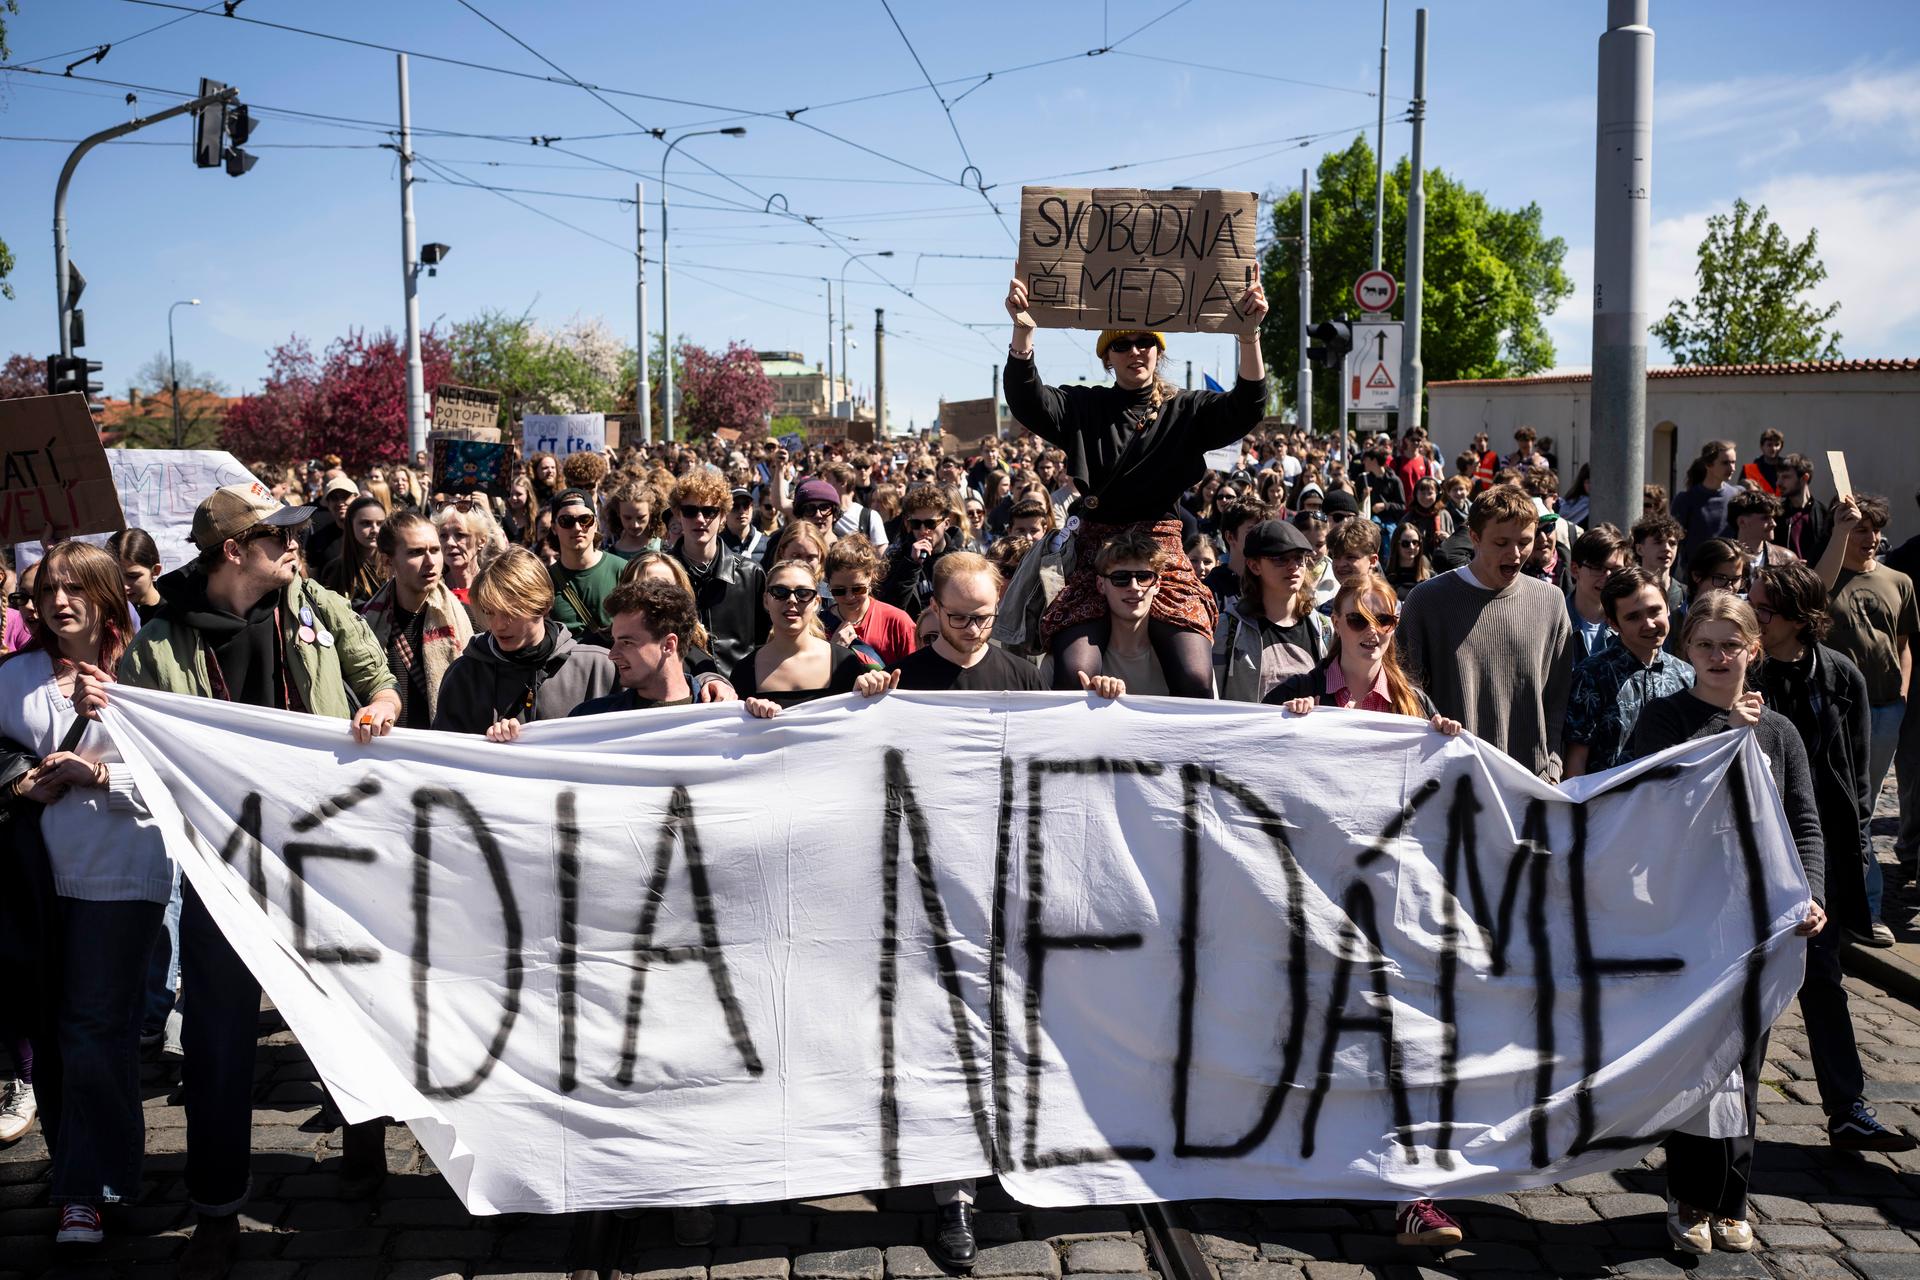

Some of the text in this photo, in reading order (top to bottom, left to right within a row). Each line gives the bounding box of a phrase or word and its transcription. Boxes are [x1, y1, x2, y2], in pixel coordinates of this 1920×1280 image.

[1033, 196, 1243, 261] SVOBODNÁ
[435, 406, 495, 423] POTOPIT
[0, 436, 67, 491] ATÍ,
